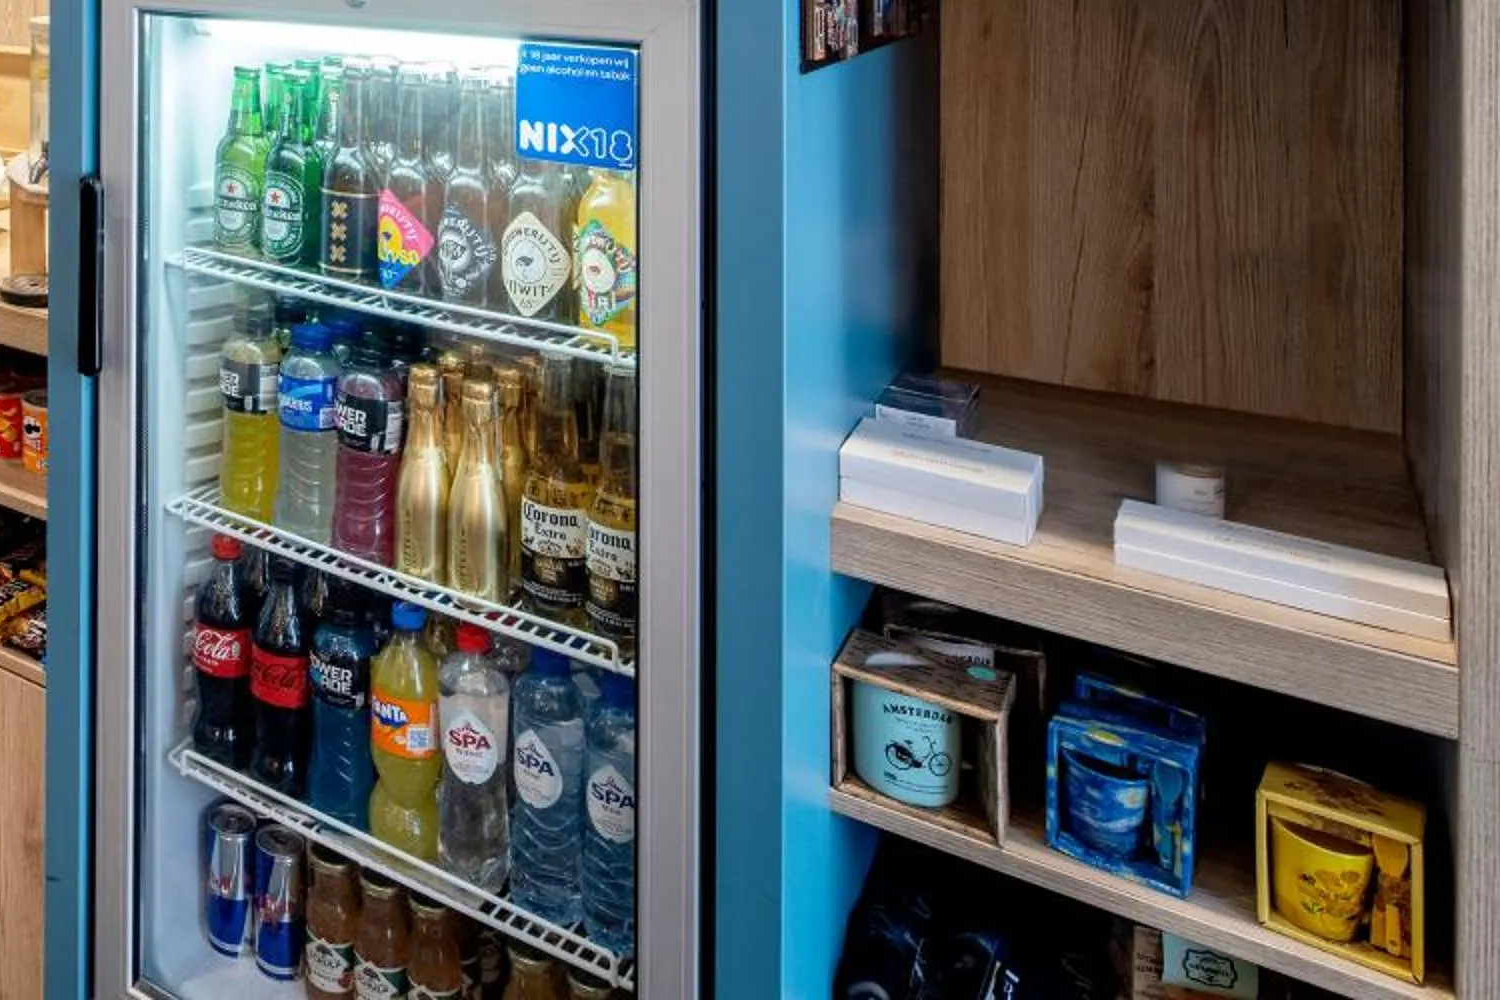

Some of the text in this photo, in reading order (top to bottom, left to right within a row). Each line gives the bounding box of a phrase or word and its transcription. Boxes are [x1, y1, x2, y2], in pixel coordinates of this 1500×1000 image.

[519, 63, 545, 75] geen
[546, 65, 583, 78] alcohol
[563, 53, 613, 67] verkopen
[519, 119, 633, 161] NIX18
[523, 502, 579, 528] Corona
[449, 729, 492, 750] SPA
[516, 746, 555, 777] SPA
[591, 781, 636, 809] SPA
